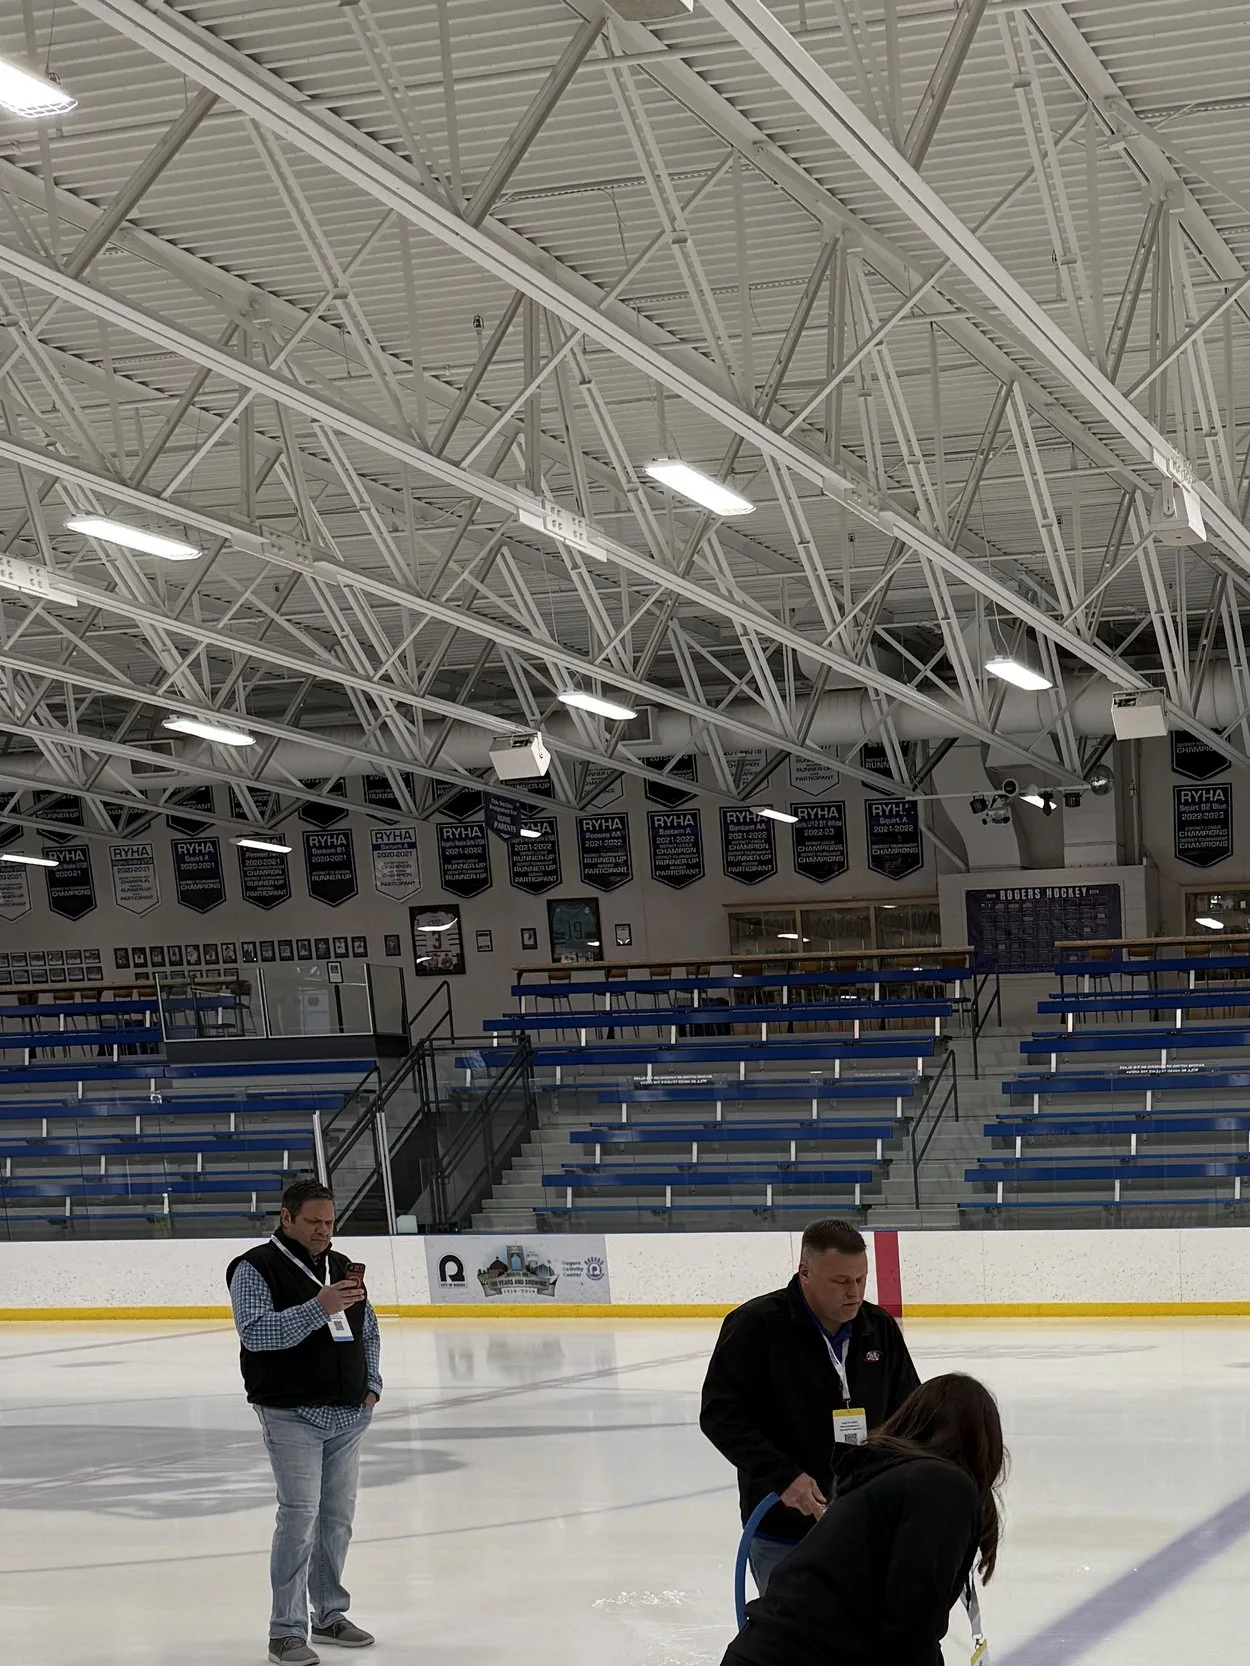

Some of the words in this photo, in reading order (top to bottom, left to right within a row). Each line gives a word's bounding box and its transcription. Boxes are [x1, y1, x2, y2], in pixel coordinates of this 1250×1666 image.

[1181, 789, 1225, 803] RYHA
[1179, 804, 1199, 812] Squirt
[727, 811, 768, 824] RYHA
[798, 807, 839, 820] RYHA
[1182, 812, 1224, 820] 2022-2023
[583, 818, 623, 831] RYHA
[654, 815, 695, 828] RYHA
[443, 826, 482, 839] RYHA
[659, 828, 684, 836] Bantam
[873, 825, 914, 833] 2021-2022
[1179, 829, 1228, 837] CHAMPIONS
[375, 830, 412, 842] RYHA
[656, 836, 695, 844] 2021-2022
[728, 832, 767, 840] 2021-2022
[309, 834, 347, 847] RYHA
[177, 842, 215, 855] RYHA
[797, 845, 843, 853] CHAMPIONS
[1179, 841, 1228, 849] CHAMPIONS
[114, 847, 150, 858] RYHA
[656, 847, 696, 855] CHAMPION
[872, 847, 918, 855] CHAMPIONS
[49, 850, 85, 862] RYHA
[656, 868, 700, 877] PARTICIPANT
[180, 883, 221, 891] CHAMPIONS
[247, 889, 287, 897] PARTICIPANT
[1000, 889, 1041, 900] ROGERS
[1046, 887, 1087, 899] HOCKEY
